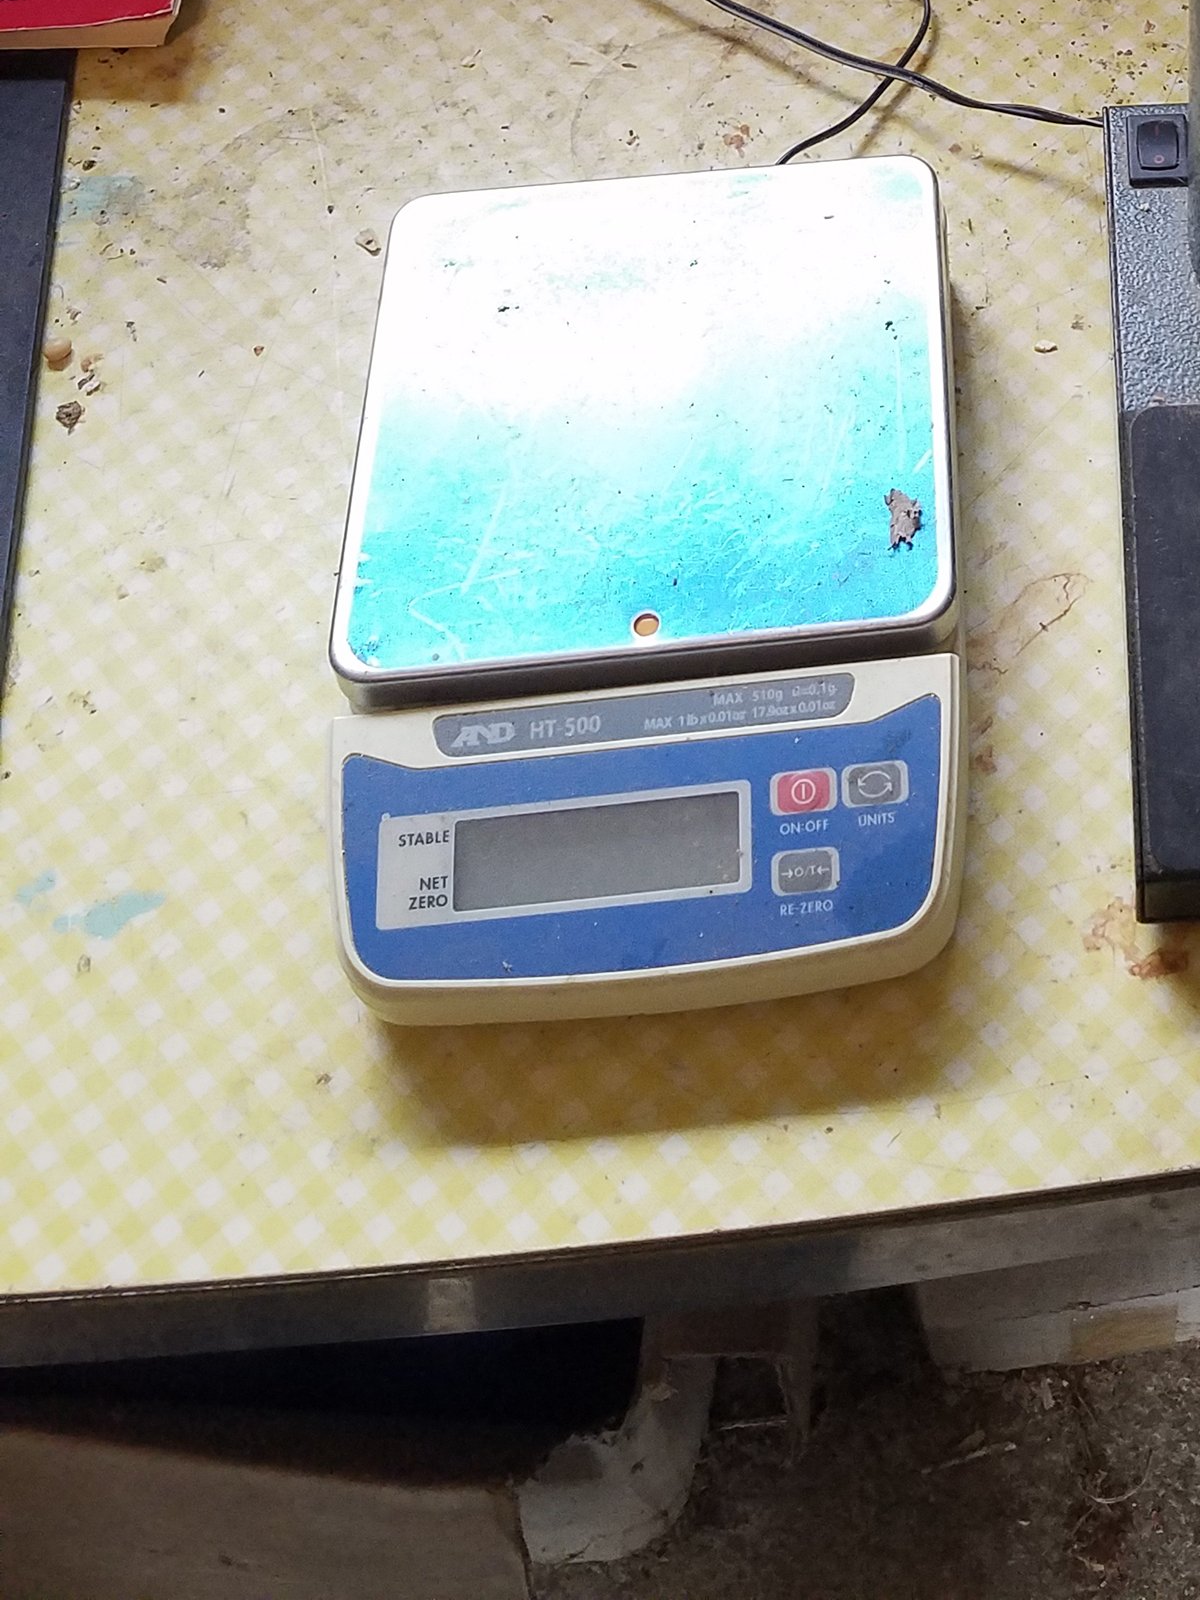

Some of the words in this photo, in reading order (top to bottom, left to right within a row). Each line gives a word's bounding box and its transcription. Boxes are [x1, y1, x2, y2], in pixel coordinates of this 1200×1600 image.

[713, 693, 744, 706] MAX
[752, 688, 784, 702] 510g
[530, 715, 601, 740] HT-500
[643, 716, 673, 730] MAX
[858, 811, 896, 827] UNITS
[398, 830, 450, 847] STABLE
[420, 875, 448, 891] NET
[409, 894, 448, 911] ZERO
[780, 899, 834, 917] RE-ZERO
